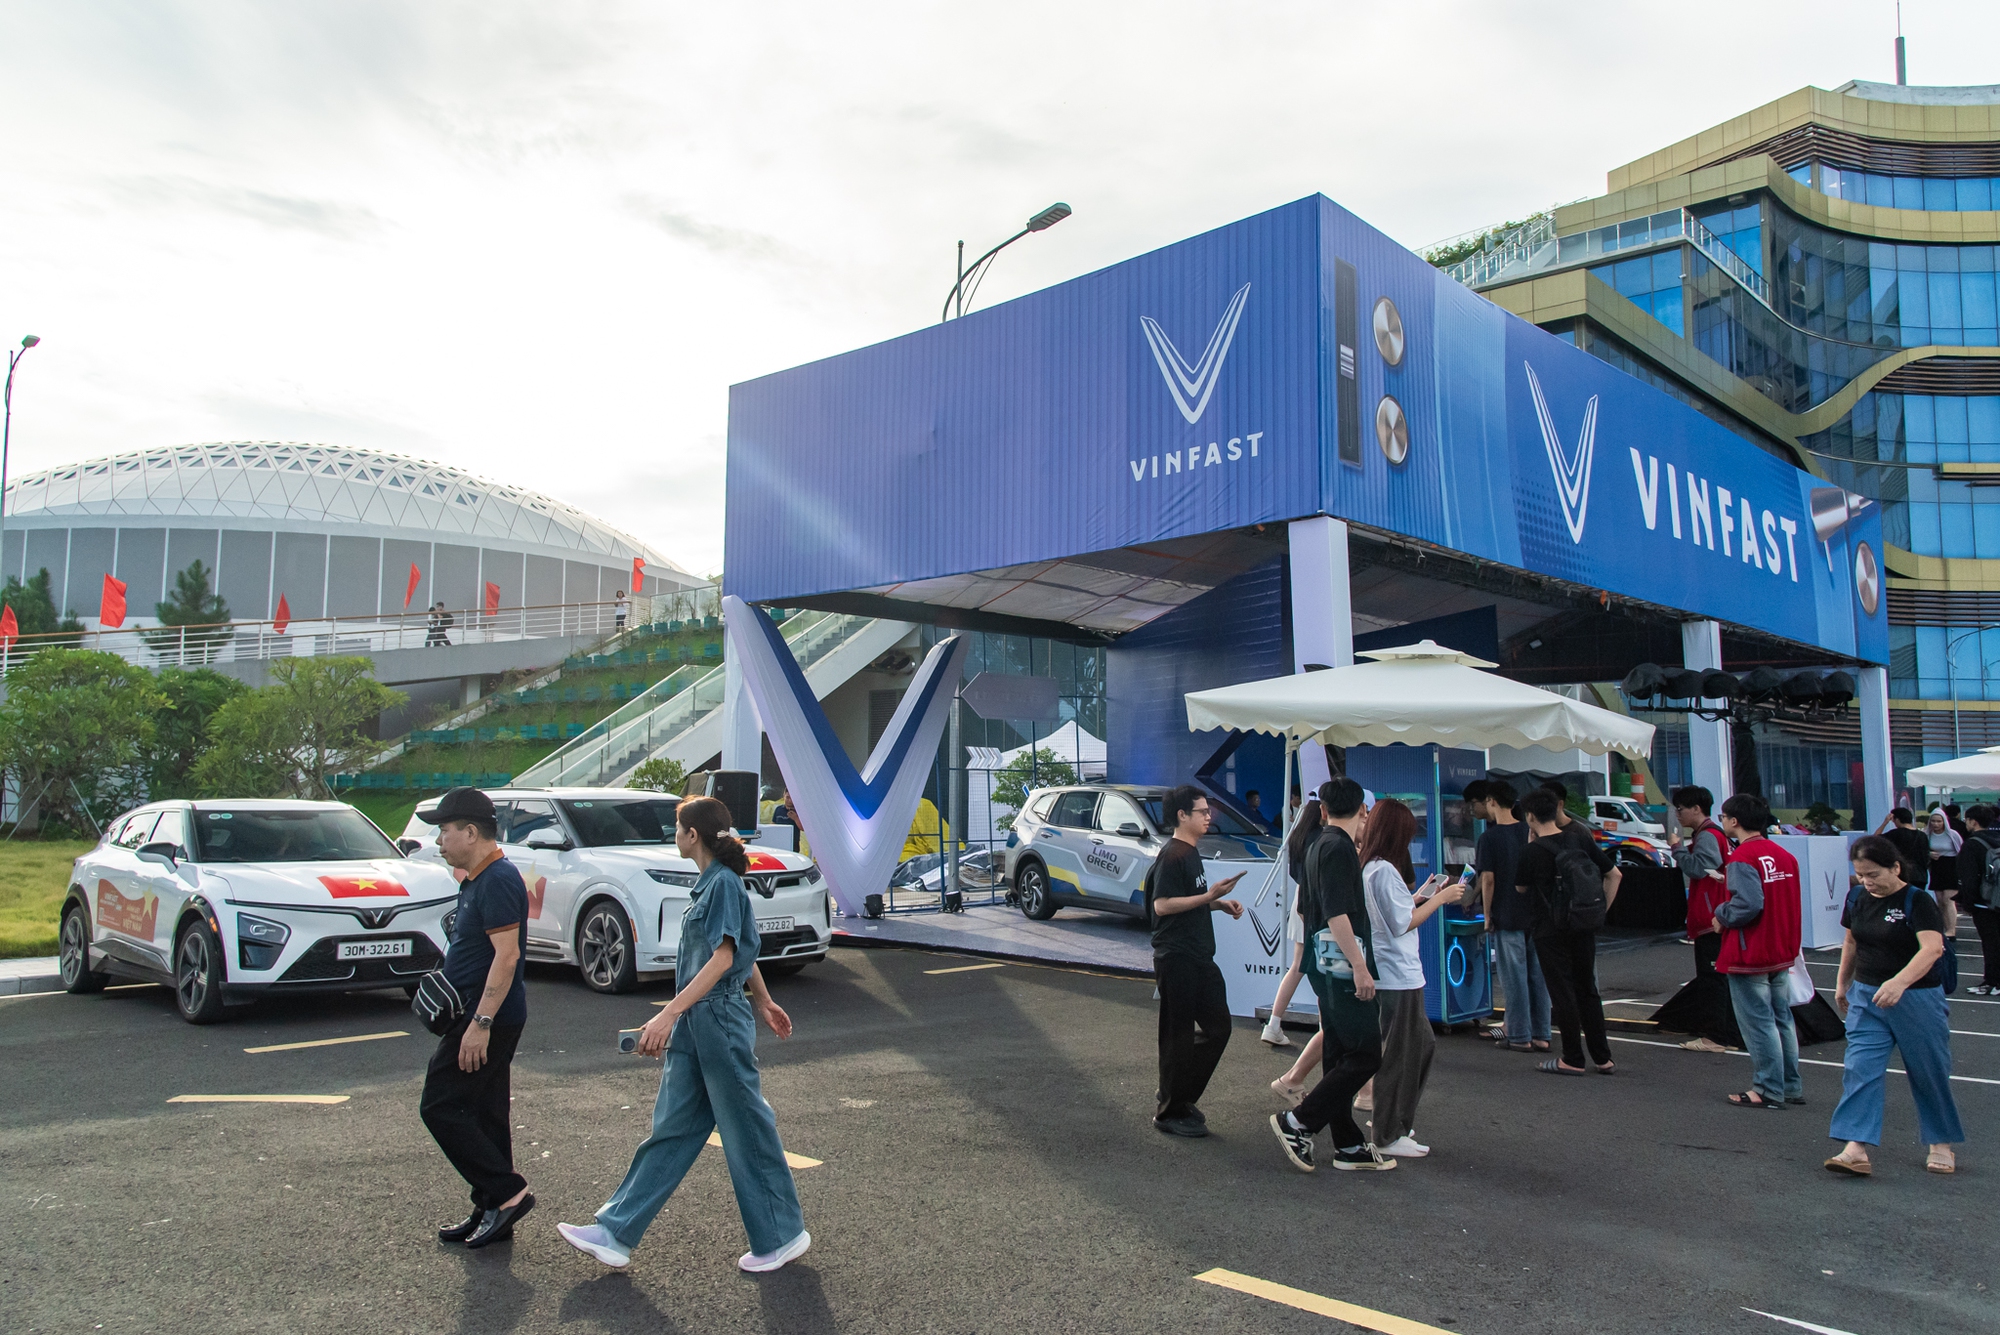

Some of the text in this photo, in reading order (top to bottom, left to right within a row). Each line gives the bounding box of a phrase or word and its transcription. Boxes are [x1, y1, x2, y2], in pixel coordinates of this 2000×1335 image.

[1130, 431, 1263, 482] VINFAST
[1629, 446, 1798, 583] VINFAST
[1092, 846, 1117, 863] LIMO
[1086, 854, 1121, 875] GREEN
[756, 920, 791, 932] M-322.82
[344, 942, 406, 957] 30M-322.61
[1244, 963, 1290, 976] VINFA
